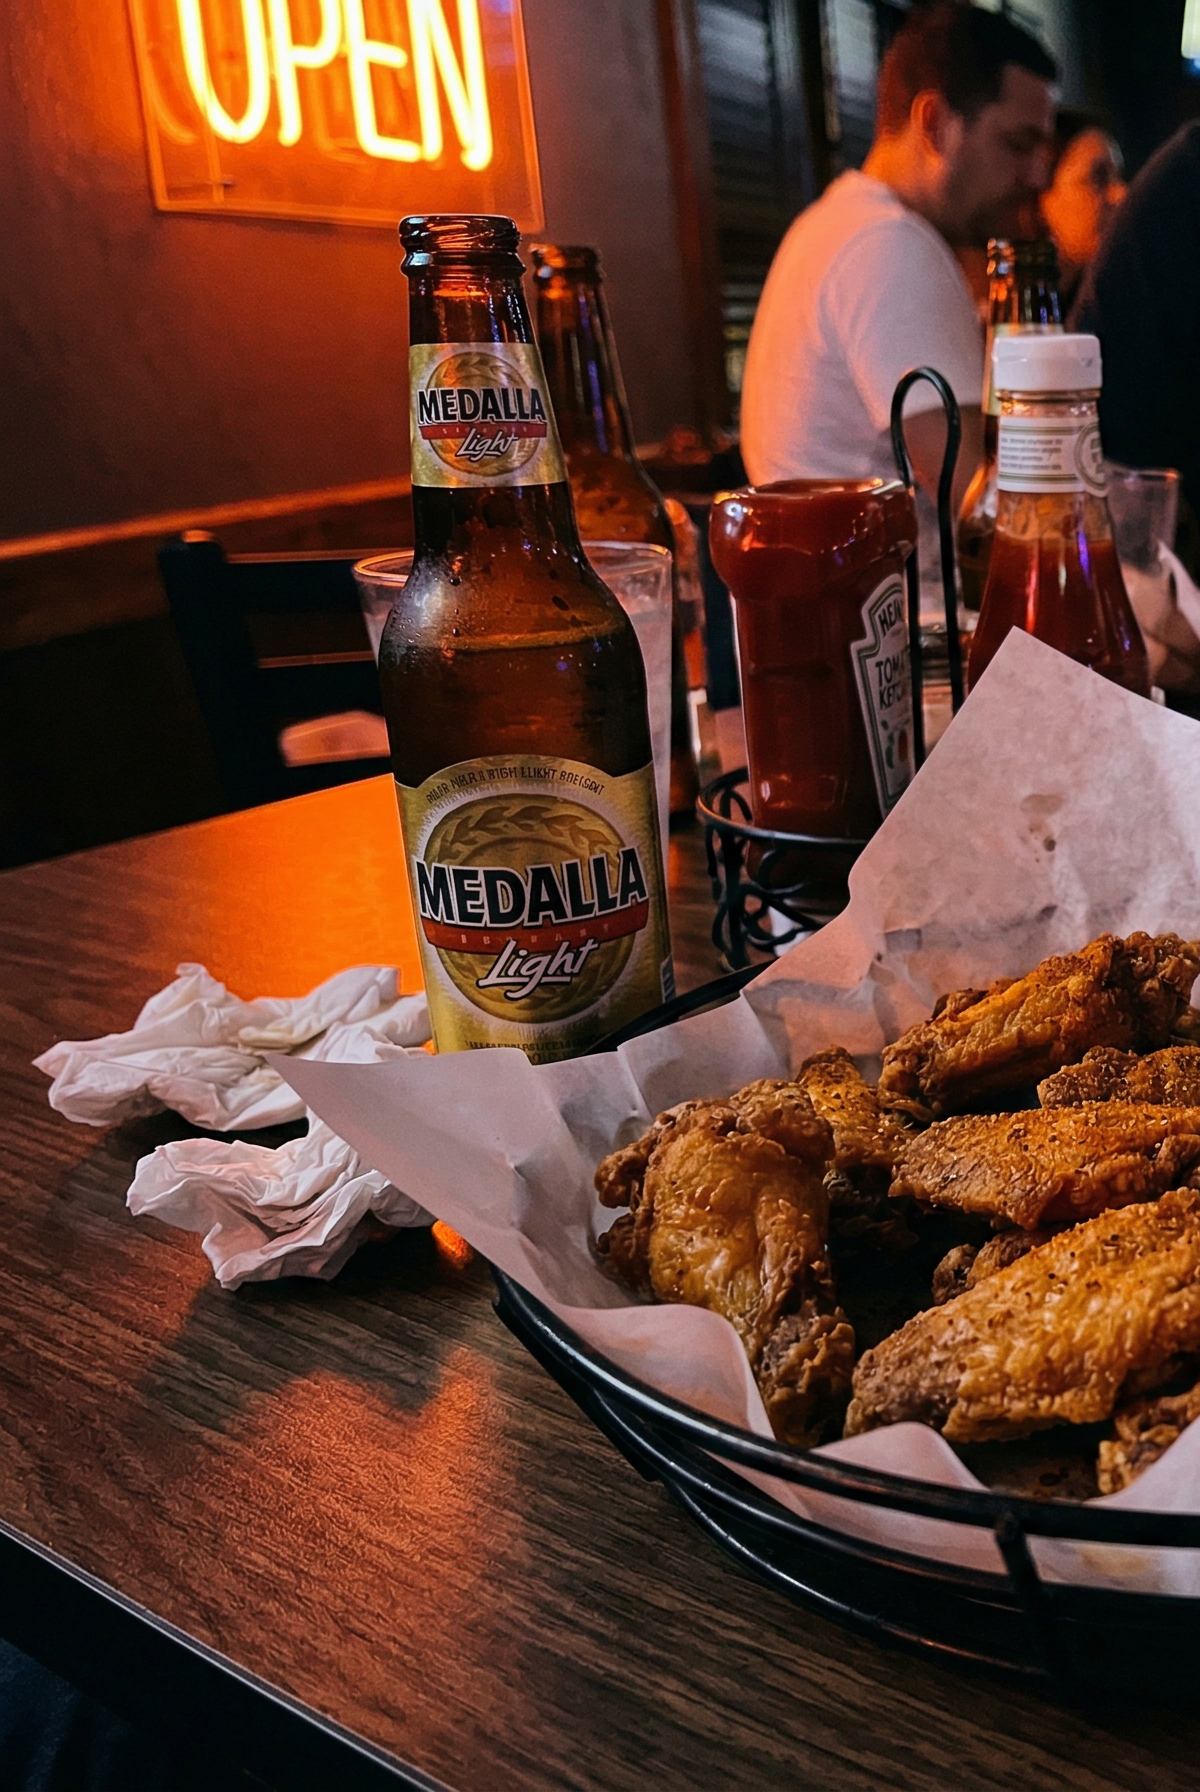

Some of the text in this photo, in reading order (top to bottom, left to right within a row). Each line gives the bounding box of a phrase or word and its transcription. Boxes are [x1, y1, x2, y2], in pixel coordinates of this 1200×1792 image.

[177, 0, 493, 171] OPEN
[417, 387, 548, 425] MEDALLA
[455, 428, 519, 462] Light
[415, 847, 649, 928] MEDALLA
[476, 938, 599, 1001] Light
